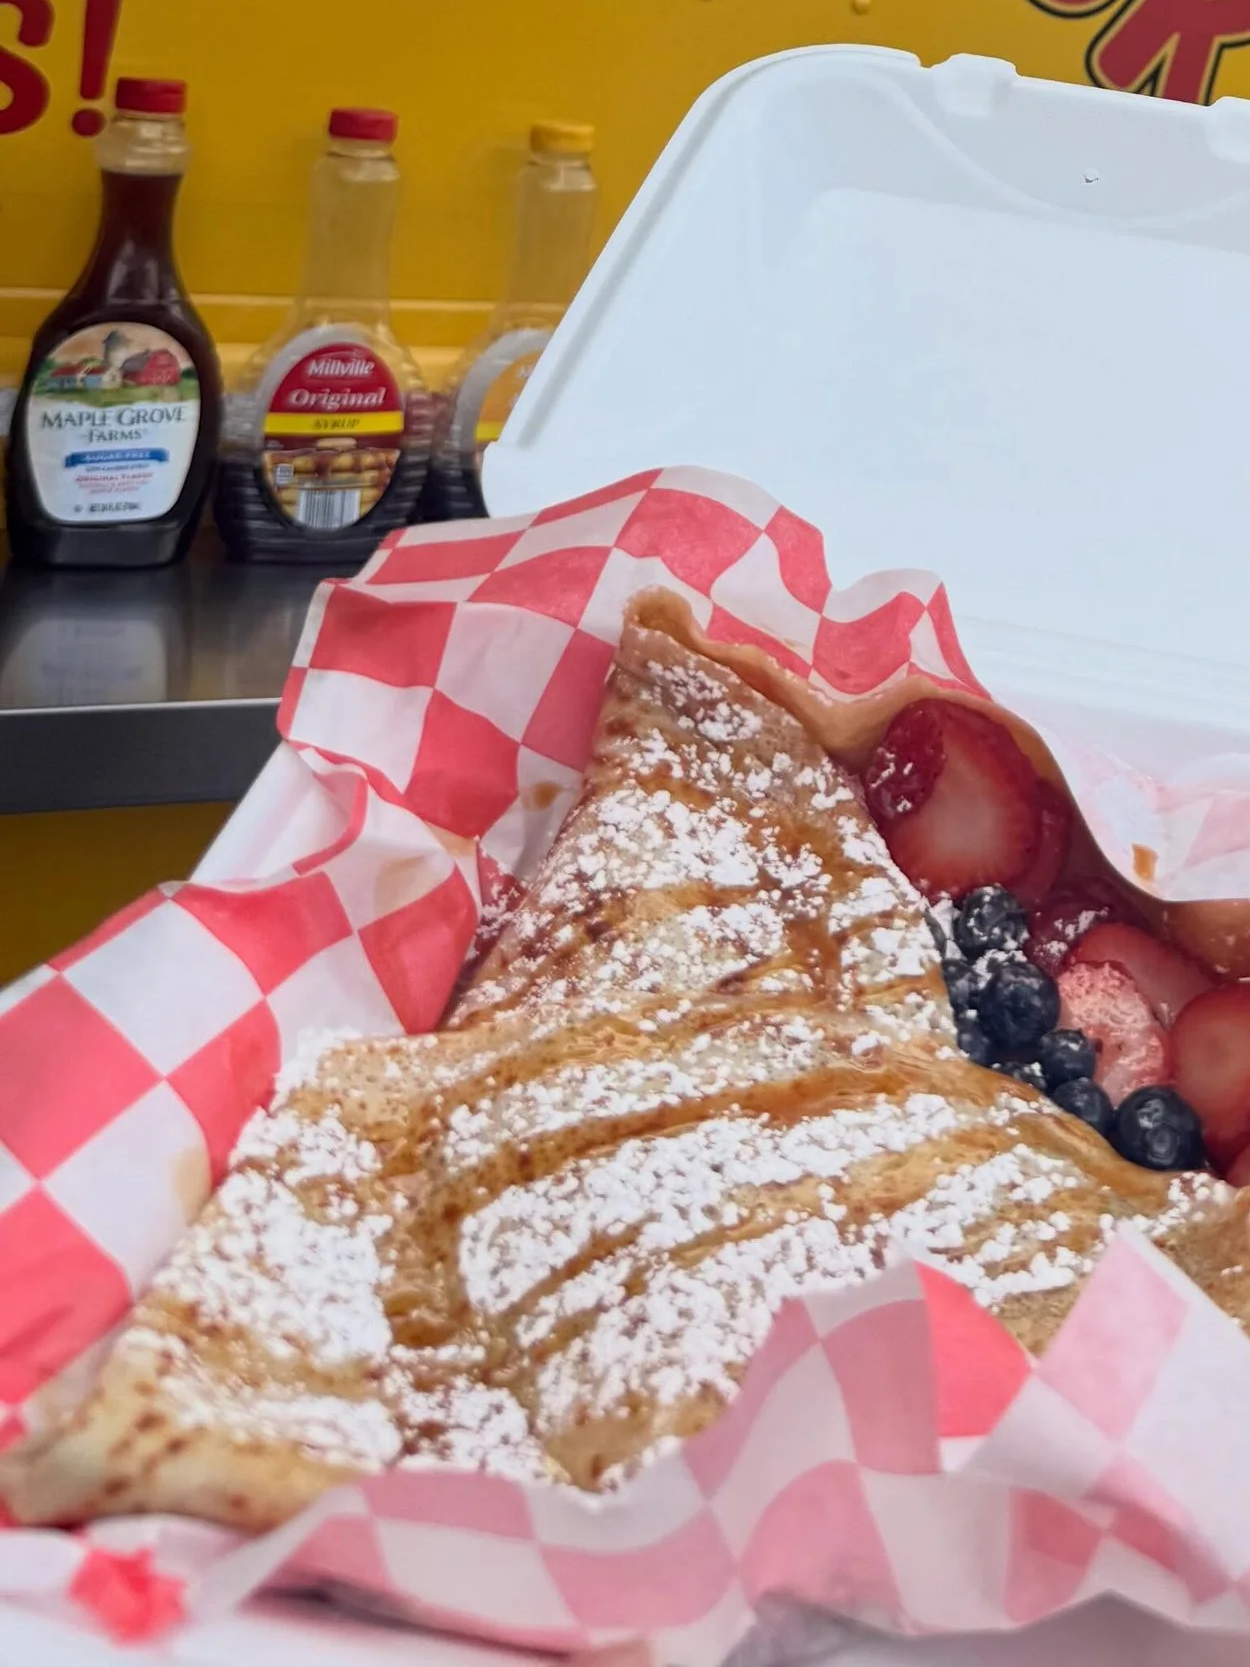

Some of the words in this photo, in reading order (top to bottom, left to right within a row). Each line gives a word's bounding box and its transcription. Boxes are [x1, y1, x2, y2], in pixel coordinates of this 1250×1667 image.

[307, 358, 375, 376] Millville
[289, 387, 387, 411] Original
[41, 410, 110, 429] MAPLE
[116, 406, 187, 427] GROVE
[87, 429, 142, 443] FARMS
